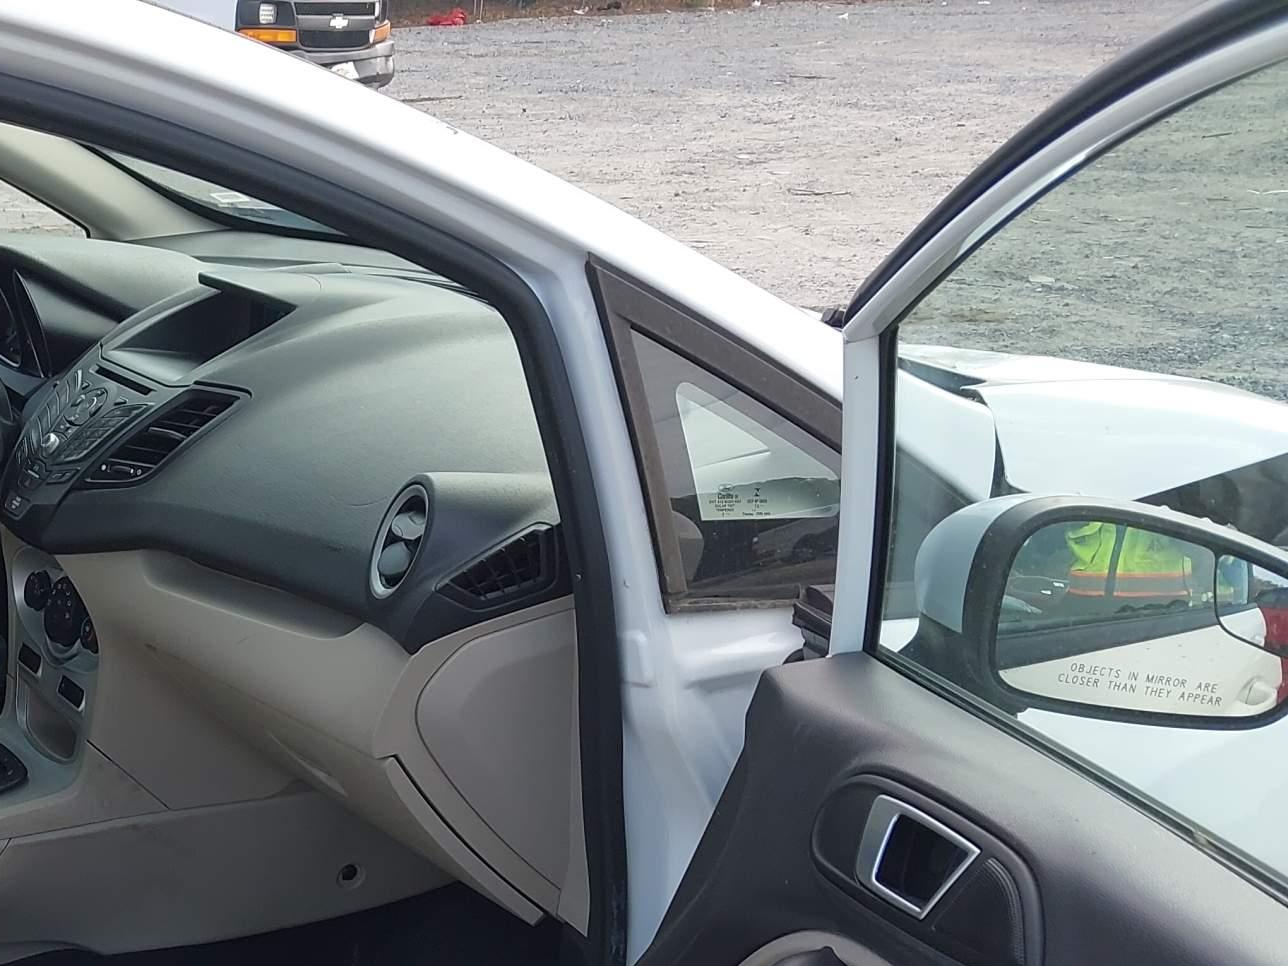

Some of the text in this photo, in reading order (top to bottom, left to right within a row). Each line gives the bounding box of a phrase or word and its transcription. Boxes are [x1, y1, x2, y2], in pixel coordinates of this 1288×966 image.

[1058, 673, 1223, 706] CLOSER THAN THEY APPEAR
[1070, 663, 1219, 694] OBJECTS IN MIRROR ARE
